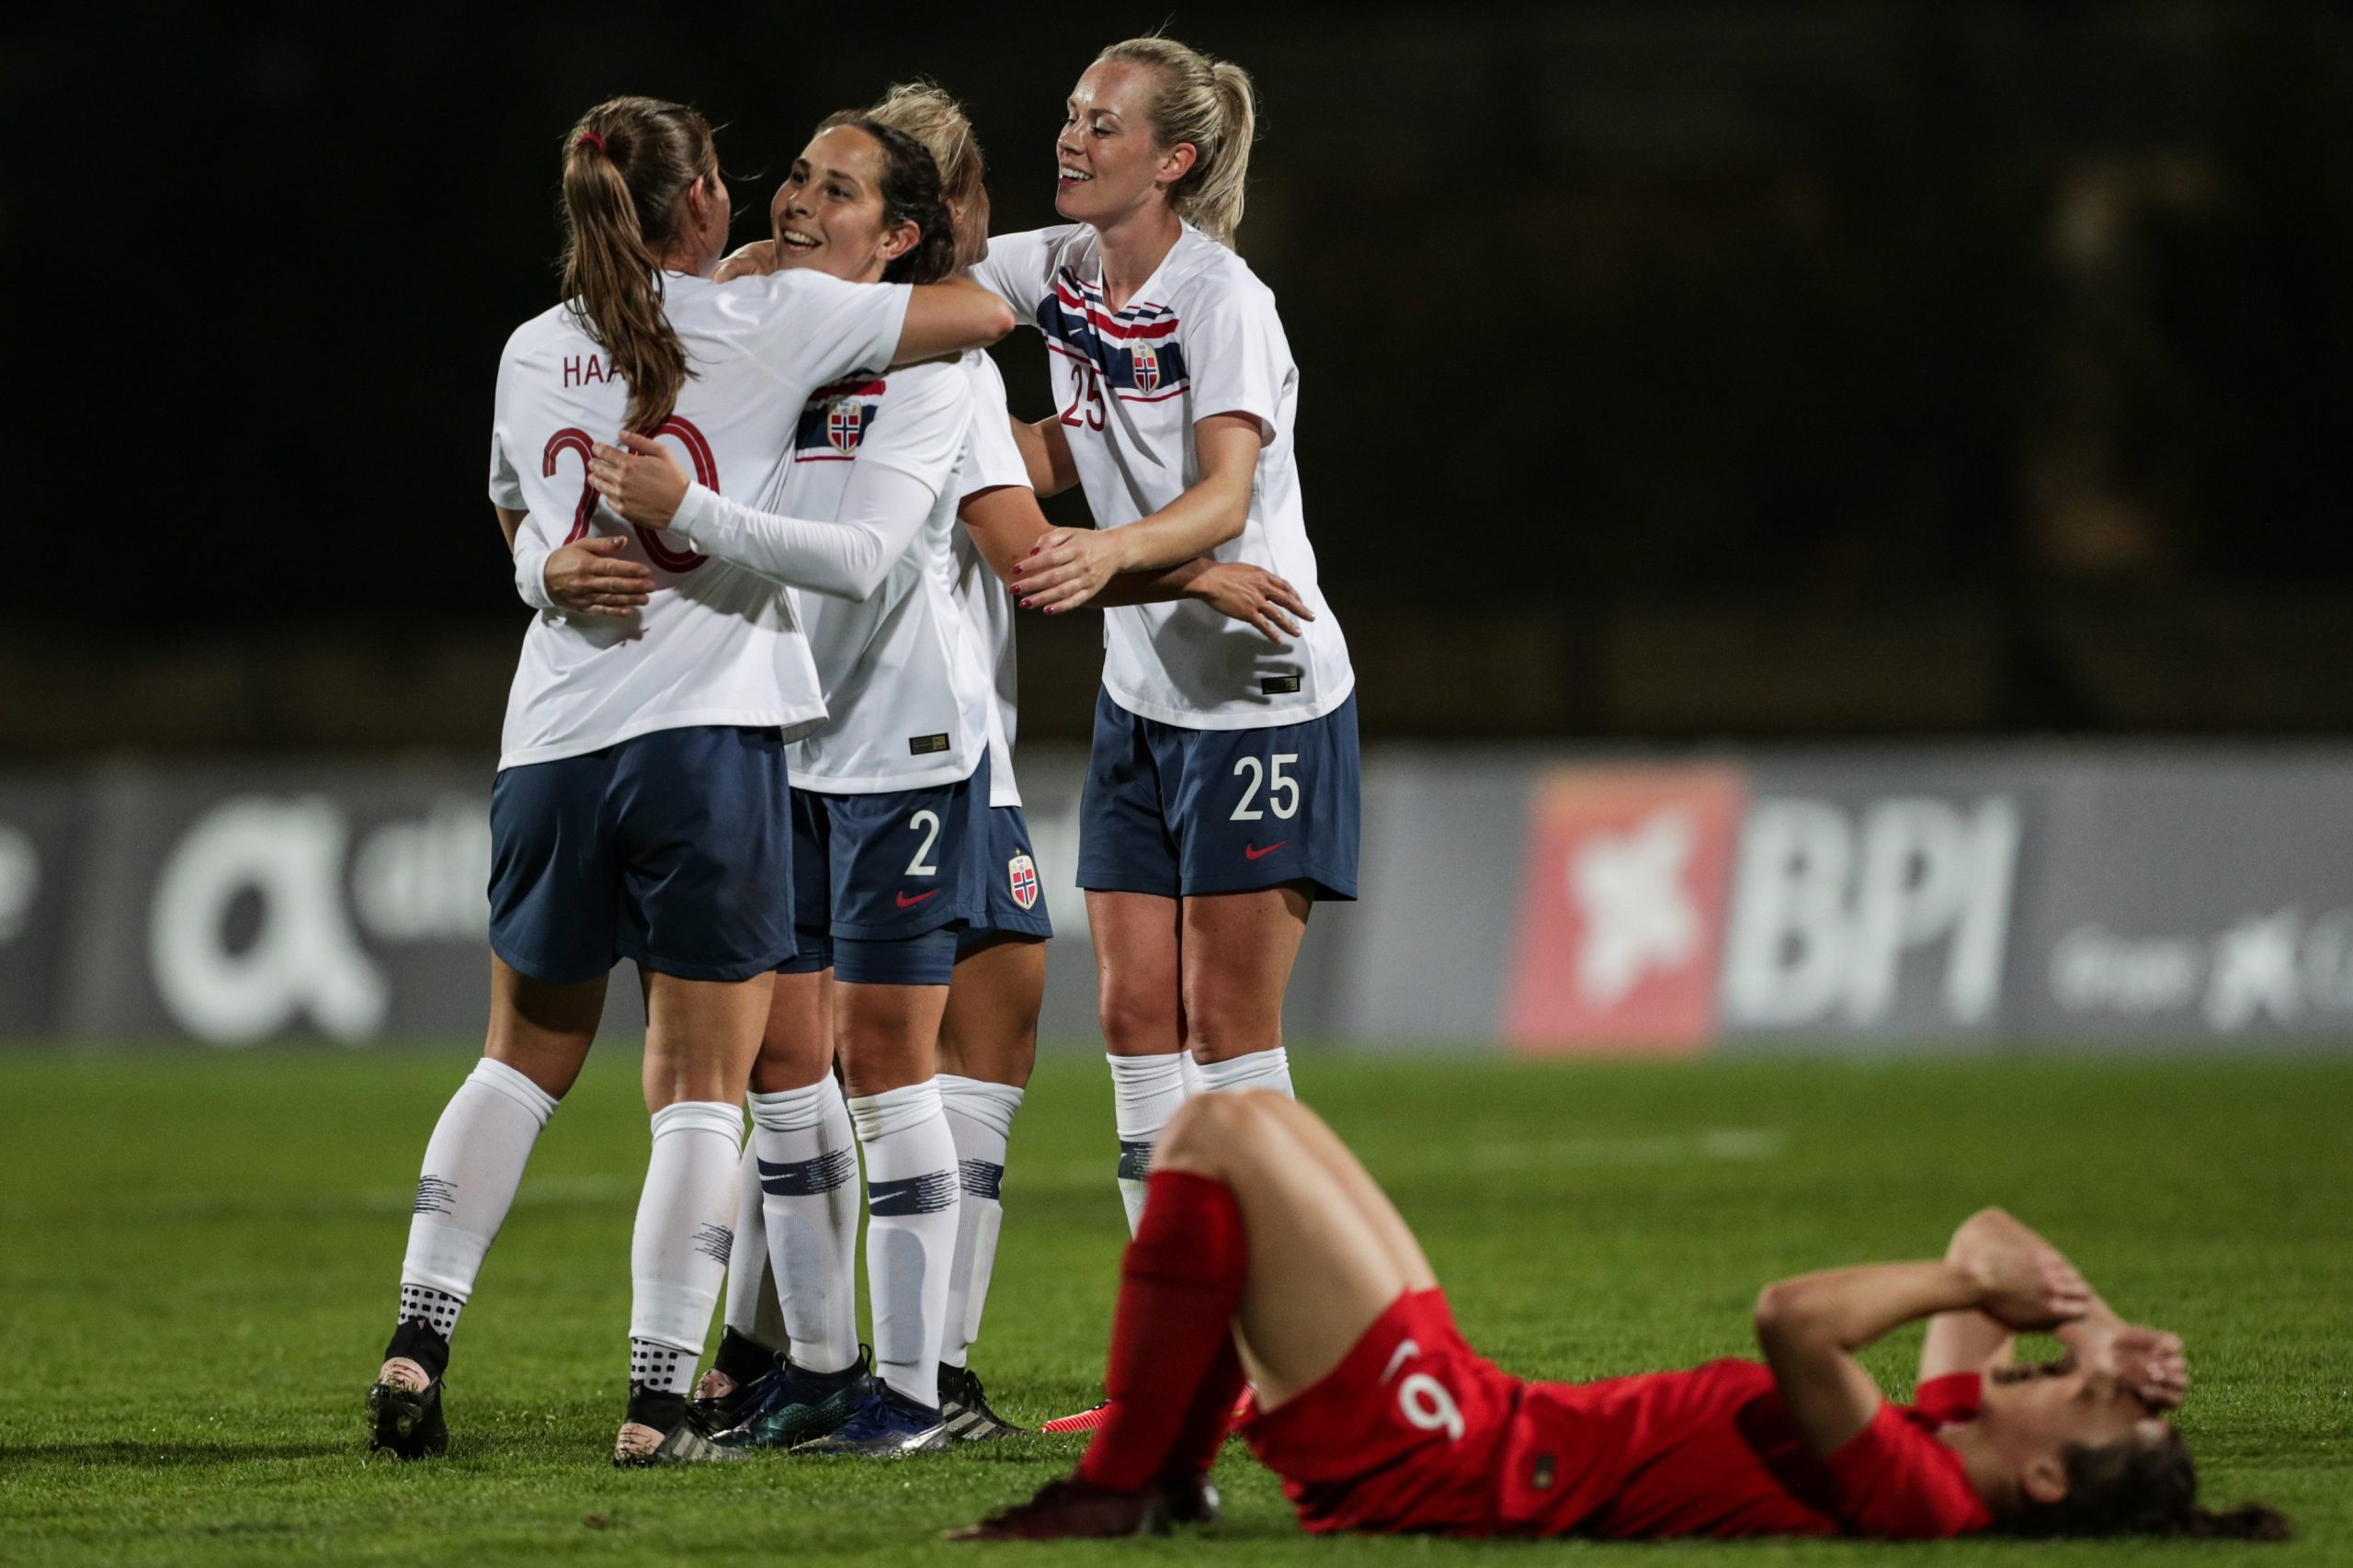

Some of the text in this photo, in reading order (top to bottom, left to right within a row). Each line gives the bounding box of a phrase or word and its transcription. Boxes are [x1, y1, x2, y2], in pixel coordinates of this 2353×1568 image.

[1061, 364, 1106, 431] 25
[542, 415, 721, 574] 20
[1230, 754, 1300, 821] 25
[904, 810, 940, 876] 2
[1722, 796, 2018, 1028] BPI
[1398, 1373, 1465, 1441] 9
